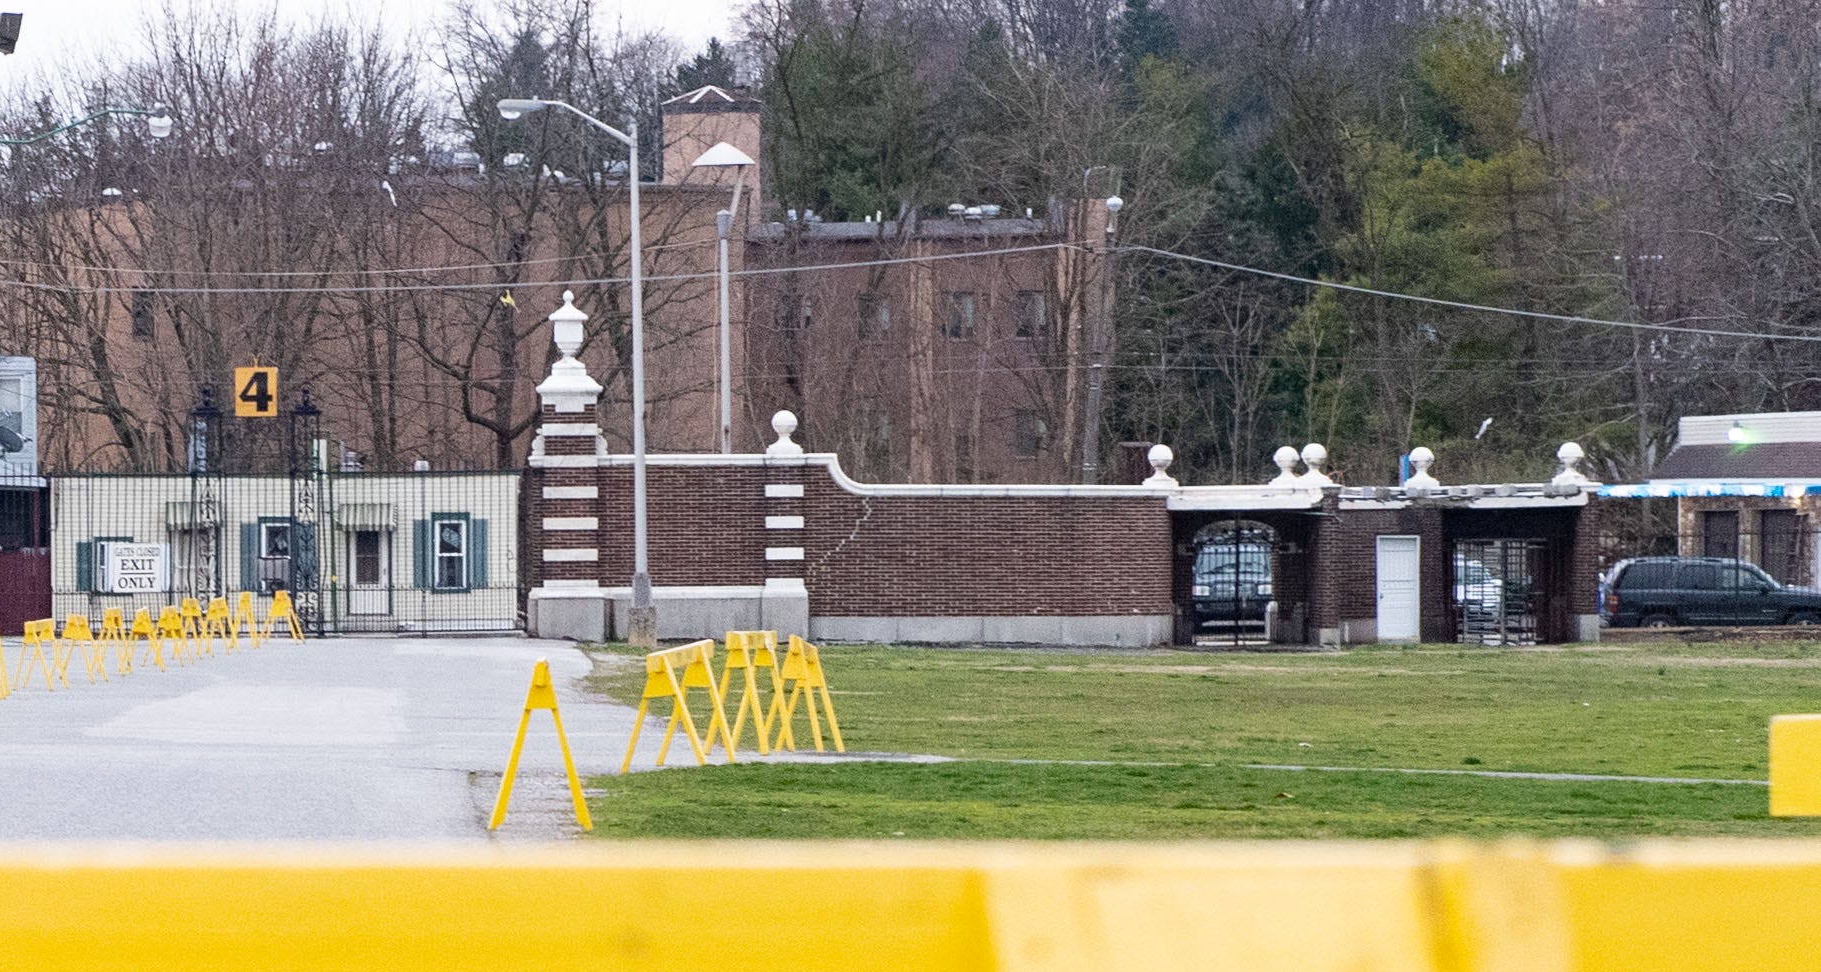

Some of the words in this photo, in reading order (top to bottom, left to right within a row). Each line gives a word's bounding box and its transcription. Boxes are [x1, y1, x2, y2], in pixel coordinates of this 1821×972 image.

[239, 371, 273, 412] 4
[121, 559, 155, 570] EXIT
[118, 577, 156, 589] ONLY
